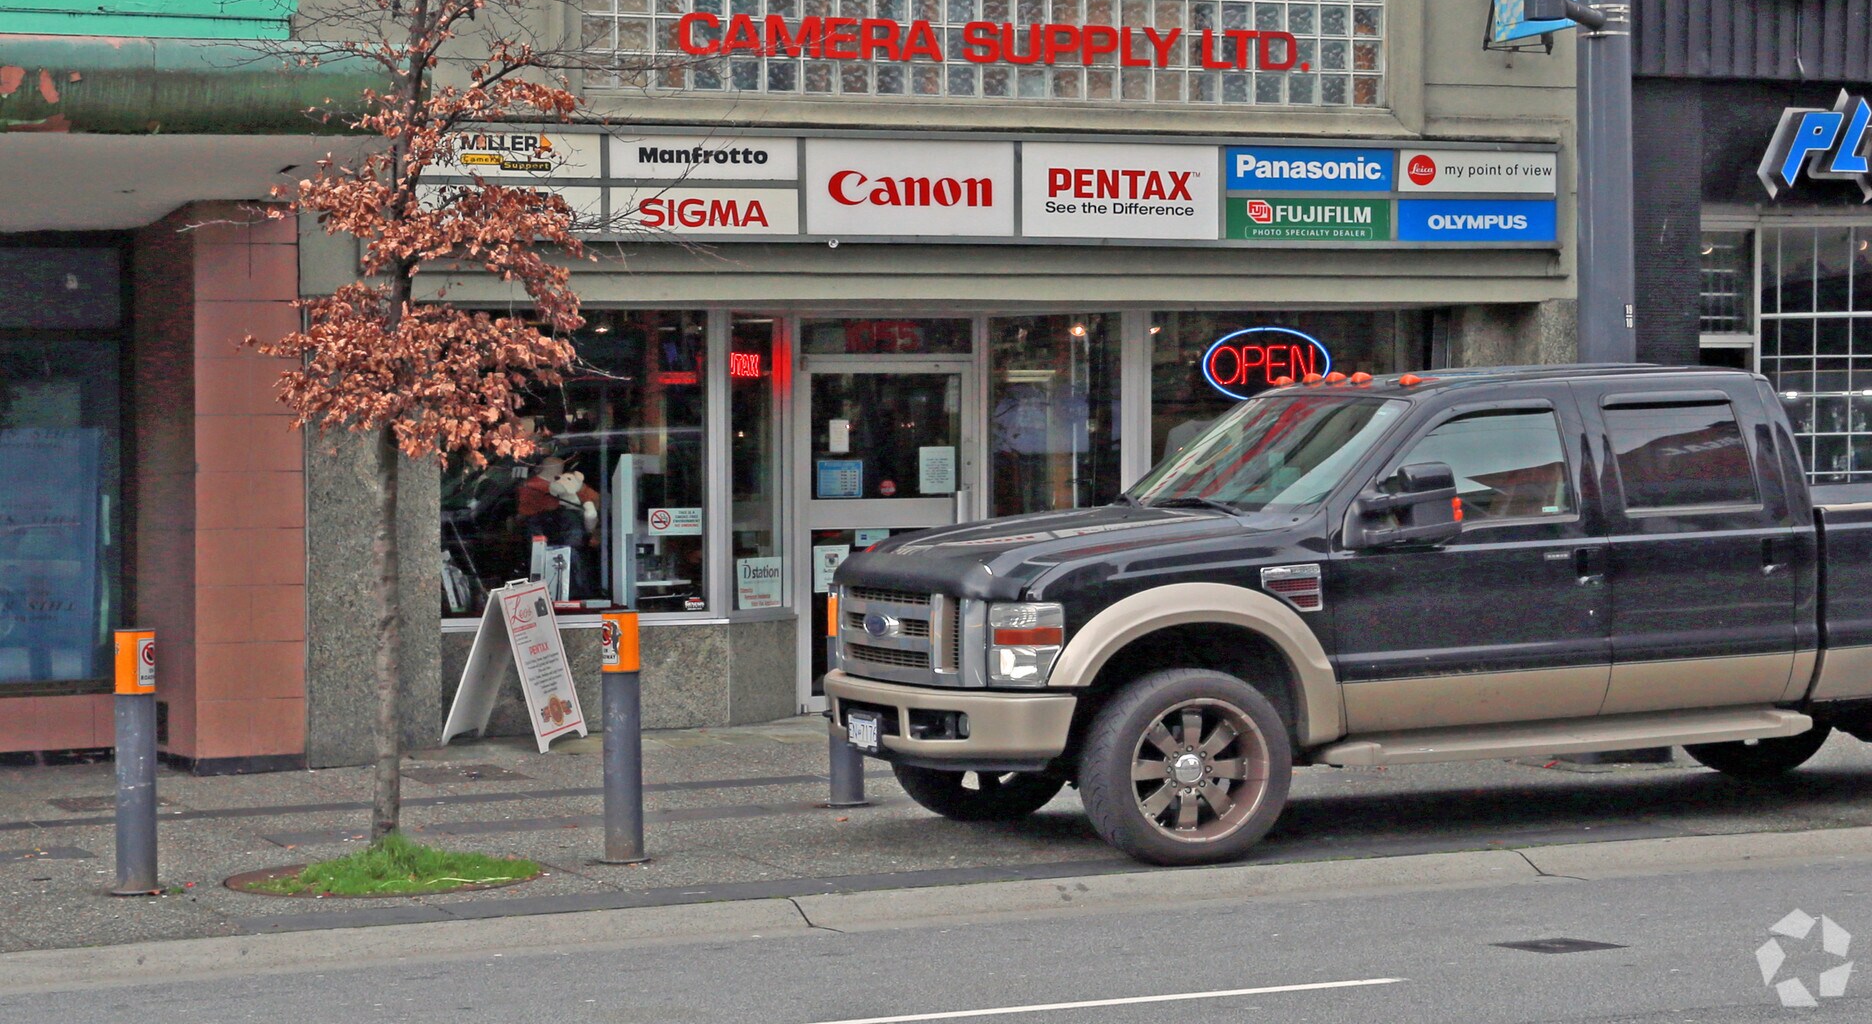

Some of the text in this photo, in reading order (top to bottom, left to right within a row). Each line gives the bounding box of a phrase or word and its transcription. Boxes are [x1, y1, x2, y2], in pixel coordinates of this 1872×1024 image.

[678, 12, 1310, 73] CAMERA SUPPLY LTD.
[460, 134, 538, 152] MILLER
[638, 146, 769, 166] Manfrotto
[503, 162, 550, 171] Support
[1236, 154, 1382, 180] Panasonic
[1409, 162, 1434, 176] Leica
[1445, 163, 1553, 178] my point of view
[827, 170, 993, 208] Canon
[1048, 168, 1193, 201] PENTAX
[638, 198, 770, 228] SIGMA
[1045, 201, 1195, 216] See the Difference
[1275, 205, 1372, 224] FUJIFILM
[1427, 214, 1528, 230] OLYMPUS
[1252, 228, 1366, 237] PHOTO SPECIALTY DEALER
[1211, 344, 1316, 385] OPEN
